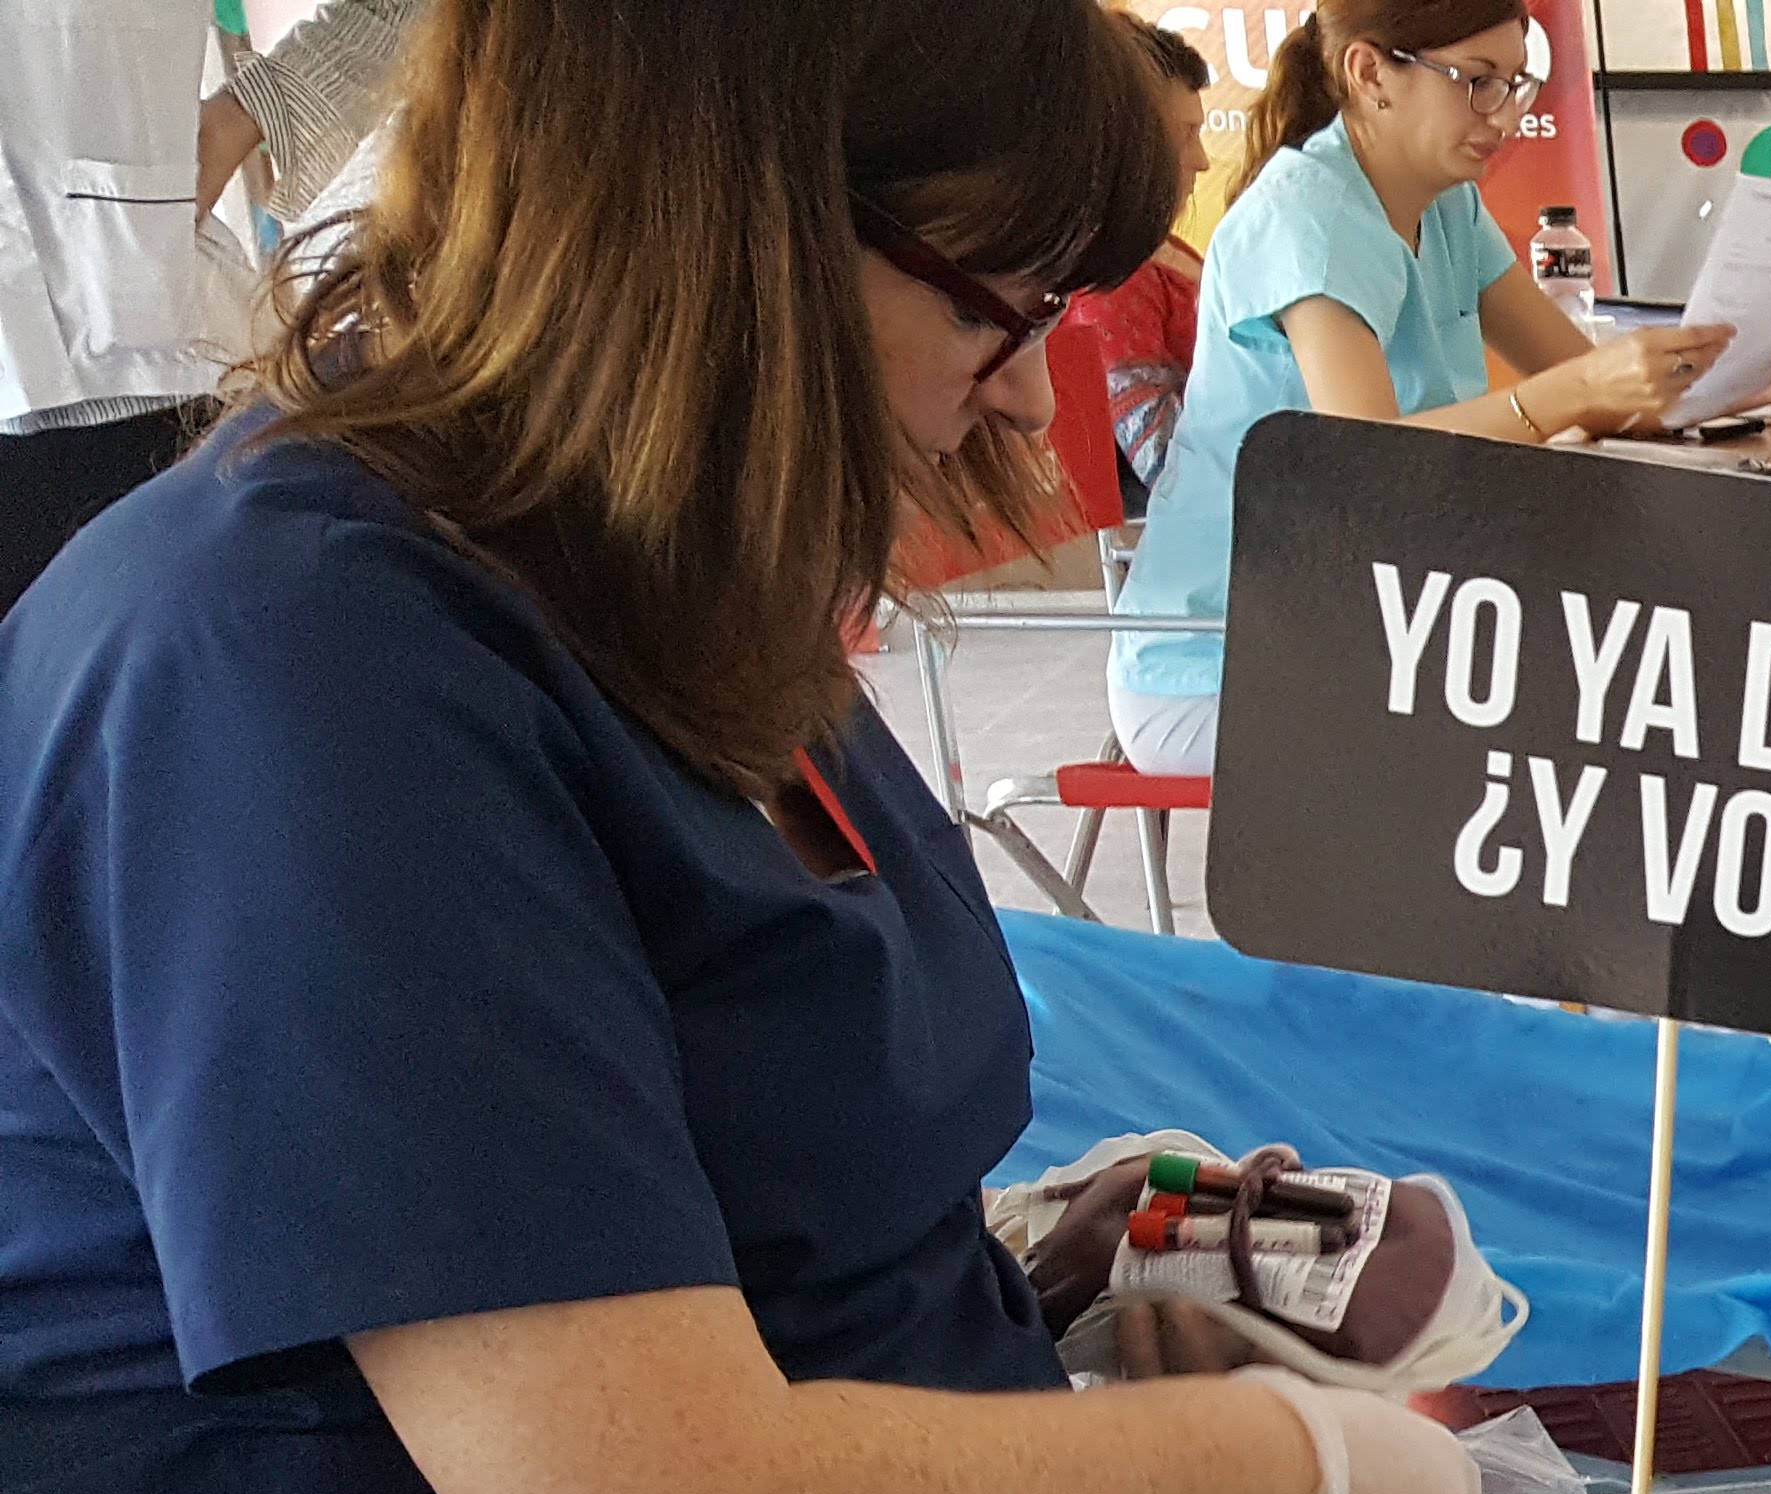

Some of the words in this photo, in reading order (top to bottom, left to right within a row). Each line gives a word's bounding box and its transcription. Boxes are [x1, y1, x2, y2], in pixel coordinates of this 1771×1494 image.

[1372, 561, 1522, 728] YO
[1560, 590, 1700, 759] YA
[1453, 750, 1608, 908] ¿Y
